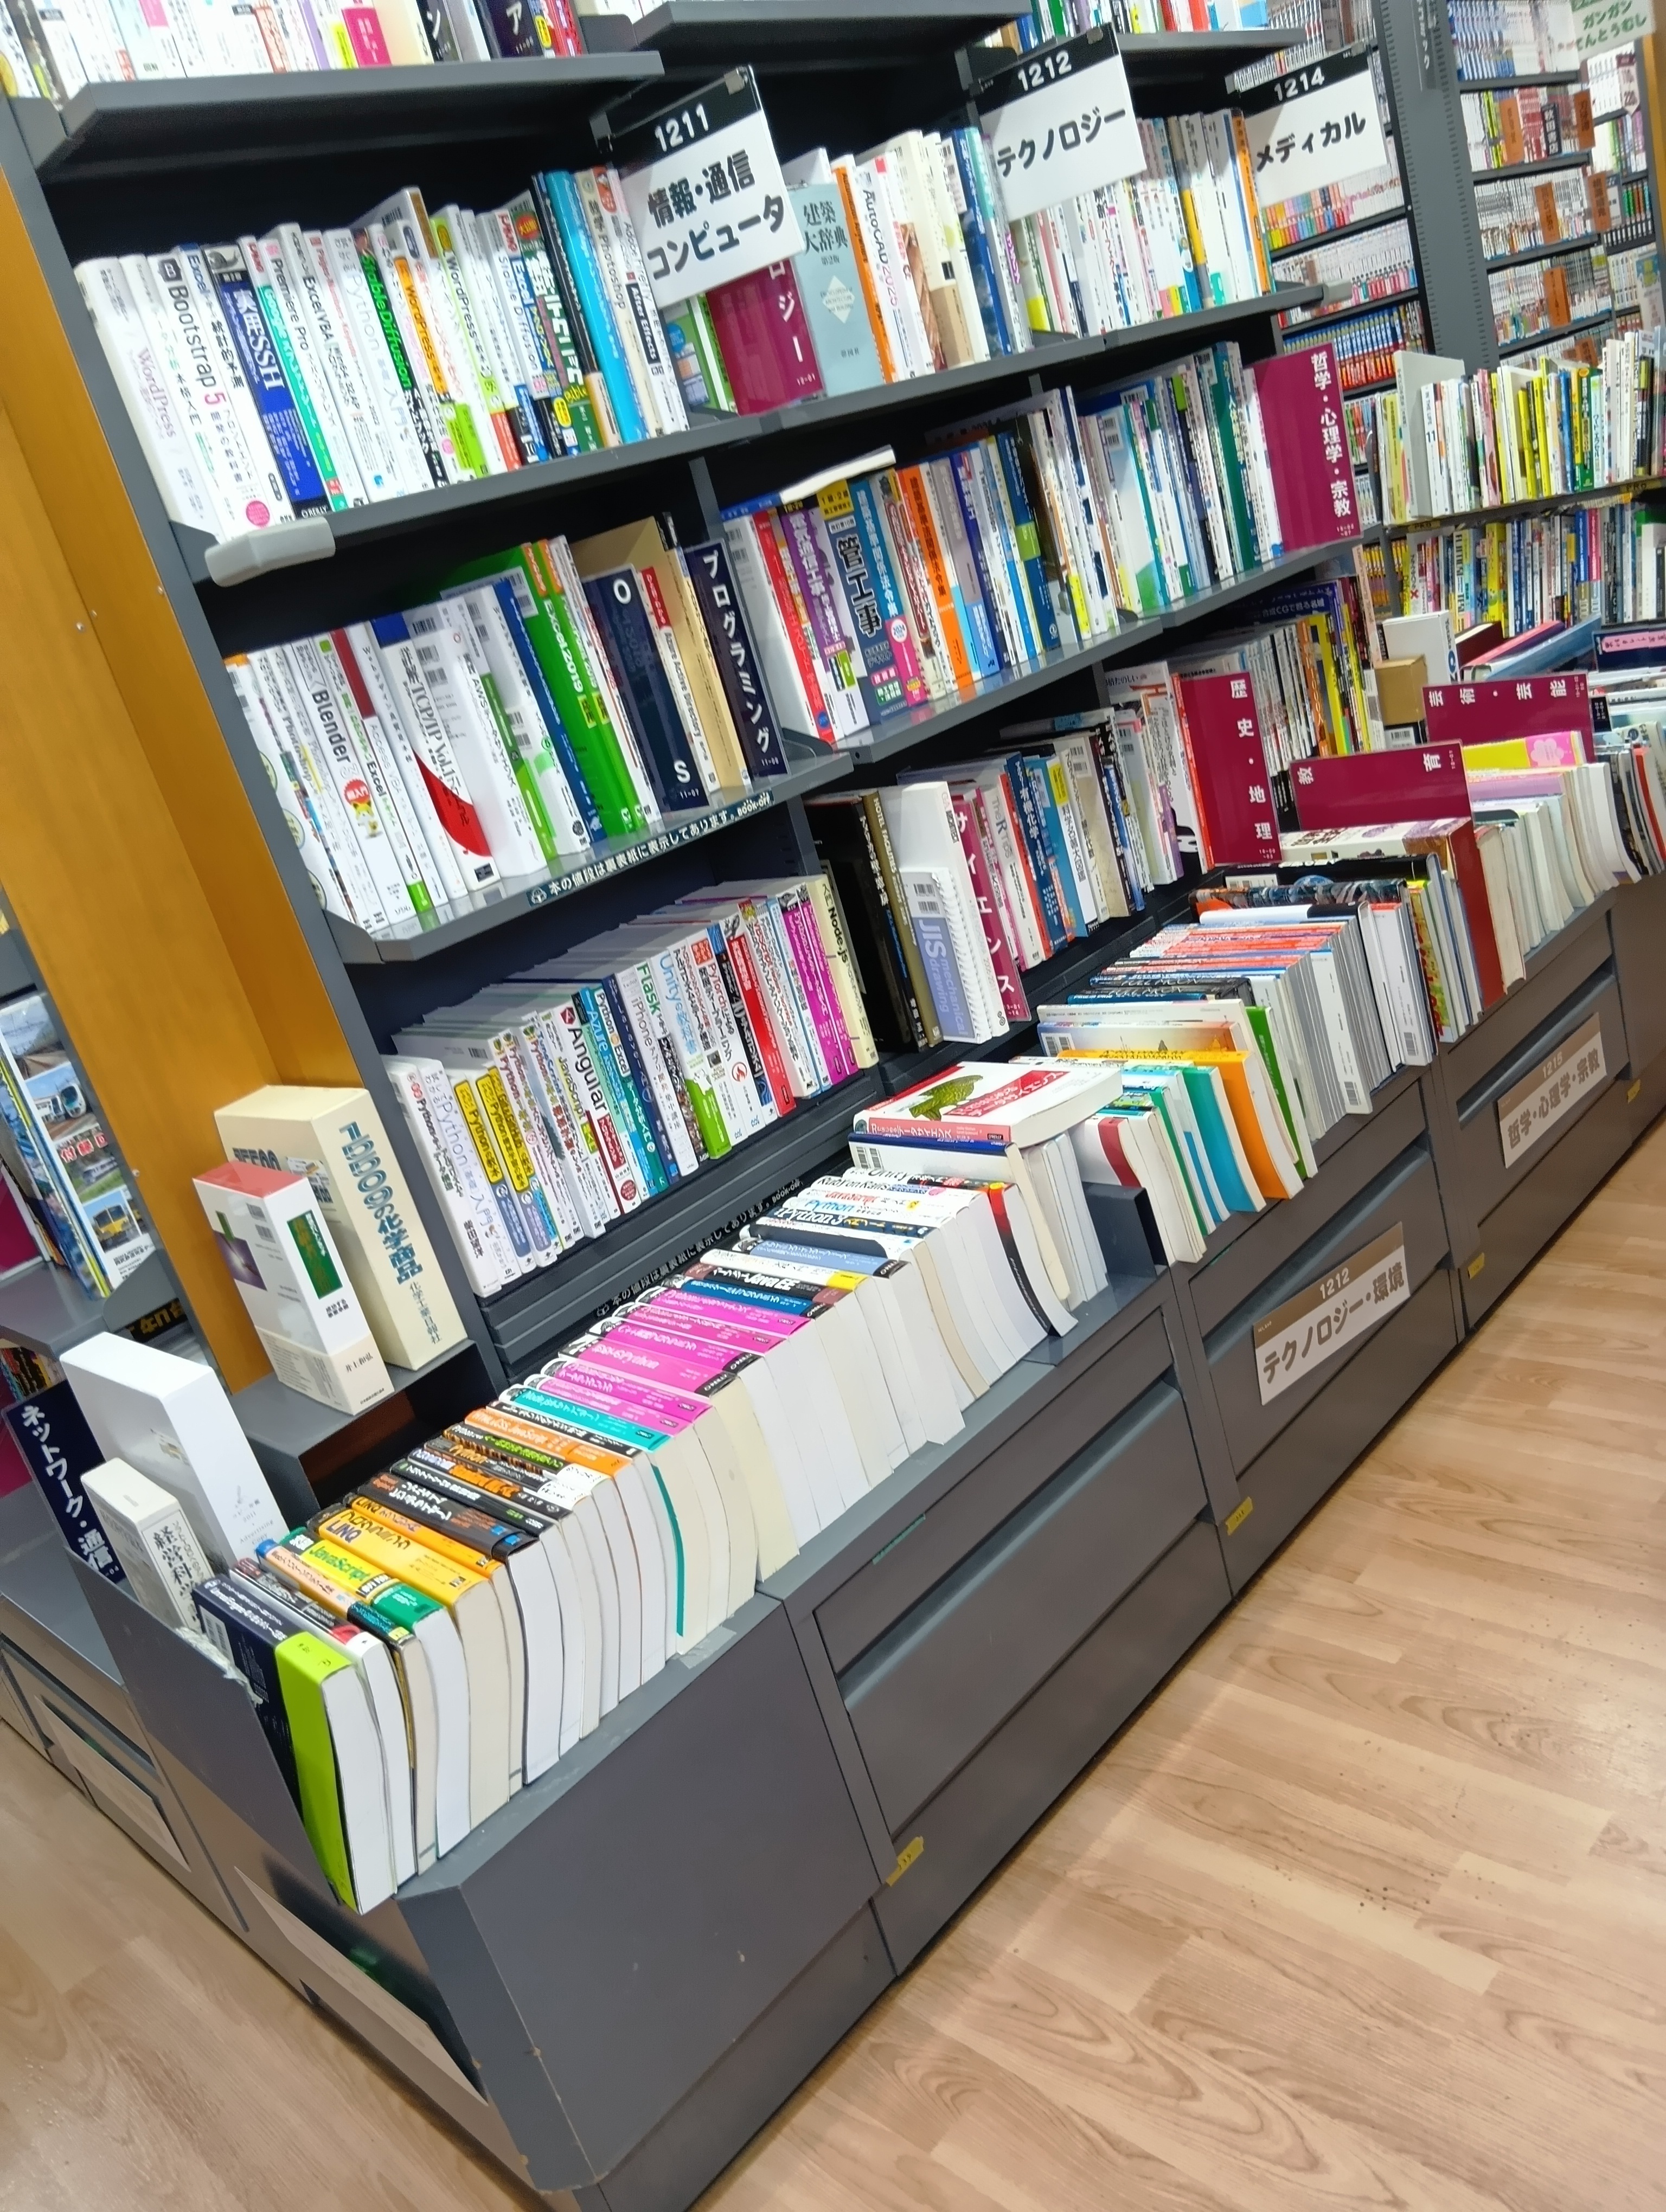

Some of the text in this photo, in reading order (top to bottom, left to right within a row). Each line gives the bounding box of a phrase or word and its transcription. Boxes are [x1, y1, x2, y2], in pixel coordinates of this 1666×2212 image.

[1017, 52, 1072, 91] 1212
[1274, 72, 1325, 102] 1214
[655, 104, 709, 151] 1211
[997, 106, 1126, 177] テクノロジー
[1256, 112, 1366, 172] メディカル
[648, 150, 756, 228] 情報・通信
[803, 201, 837, 228] 建築
[597, 233, 627, 311] Photoshop
[646, 195, 785, 280] コンピュータ
[803, 228, 849, 254] 大辞典
[862, 188, 900, 307] AutoCAD 2025
[270, 256, 311, 352] Premiere Pro
[511, 258, 534, 305] Excel
[163, 281, 226, 408] Bootstrap 5
[631, 286, 657, 361] After Effects
[136, 346, 178, 439] WordPress
[1311, 350, 1352, 518] 哲学・心理学・宗教
[977, 468, 999, 533] Twinmotion
[701, 550, 770, 751] プログラミング
[311, 687, 354, 767] Blender
[1231, 679, 1273, 840] 歴史・地理
[366, 760, 387, 798] Excel
[1297, 751, 1442, 786] 教育
[872, 797, 898, 874] HOTEL FACILITIES
[944, 809, 959, 844] ARCHITECT
[955, 812, 1015, 994] サイエンス
[635, 962, 663, 1015] Flask
[918, 914, 967, 1035] JIS mechanical
[926, 957, 951, 1014] drawing
[587, 1007, 610, 1053] Azure
[596, 992, 629, 1075] Python Excel
[555, 1054, 587, 1121] JavaScript
[566, 1024, 608, 1115] Angular
[1507, 1046, 1601, 1149] 哲学・心理学・宗教
[1541, 1053, 1564, 1078] 1215
[469, 1190, 494, 1228] 入門
[1319, 1267, 1350, 1300] 1212
[1263, 1261, 1406, 1384] テクノロジー・環境
[306, 1546, 369, 1581] JavaScript
[326, 1521, 361, 1544] LINQ
